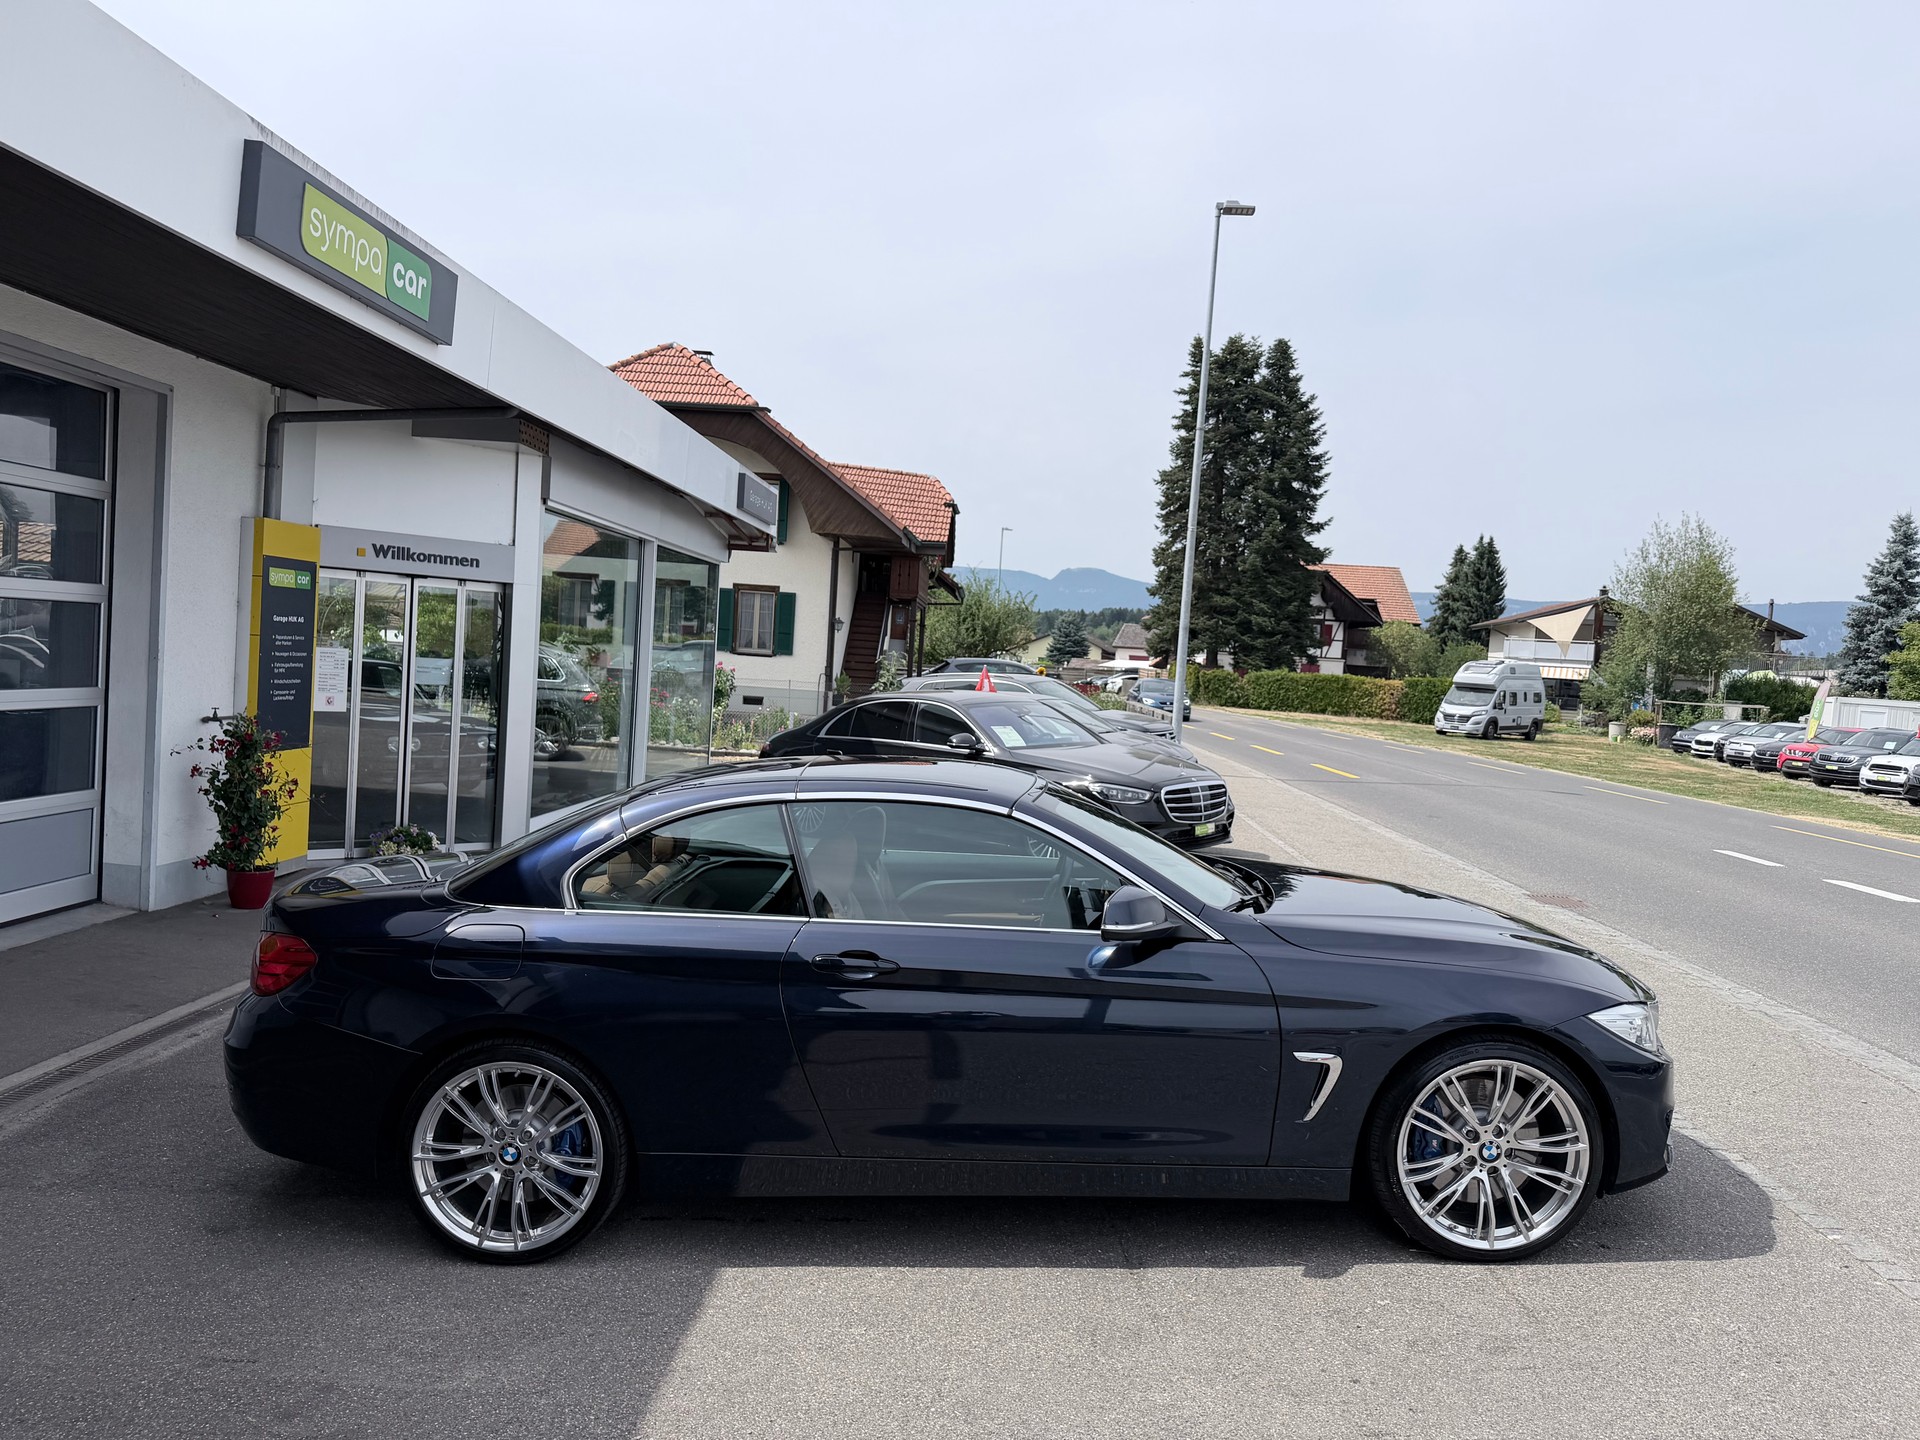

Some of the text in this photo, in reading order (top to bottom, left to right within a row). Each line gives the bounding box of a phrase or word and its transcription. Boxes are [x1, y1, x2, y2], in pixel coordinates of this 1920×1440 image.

[309, 207, 427, 300] sympa car
[372, 543, 480, 568] Willkommen
[270, 572, 309, 585] sympa car
[273, 614, 288, 623] Garage
